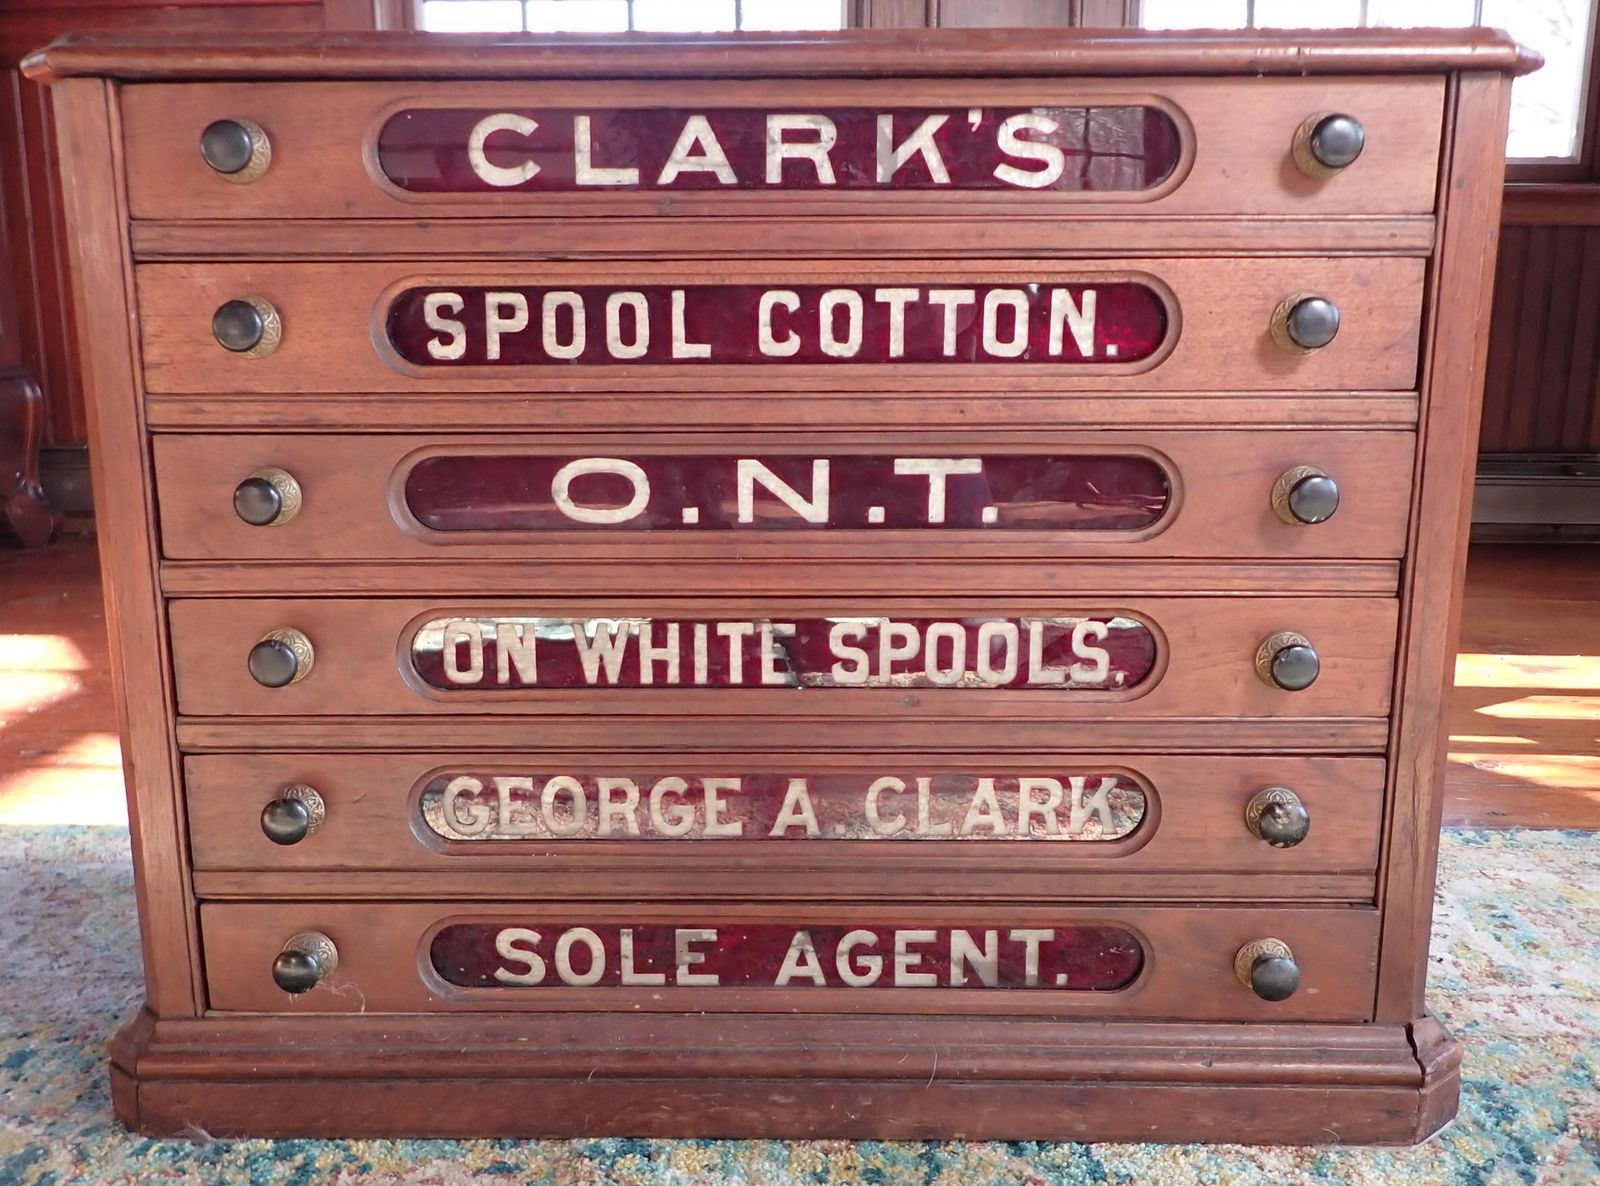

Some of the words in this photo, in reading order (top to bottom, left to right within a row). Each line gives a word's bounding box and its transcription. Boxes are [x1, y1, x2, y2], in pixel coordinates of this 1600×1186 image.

[468, 107, 1066, 188] CLARK'S
[423, 290, 711, 360] SPOOL
[758, 288, 1119, 358] COTTON.
[443, 621, 538, 684] ON
[572, 621, 796, 685] WHITE
[442, 775, 743, 836] GEORGE
[865, 776, 1118, 836] CLARK
[494, 926, 720, 986] SOLE
[774, 928, 1069, 988] AGENT.
